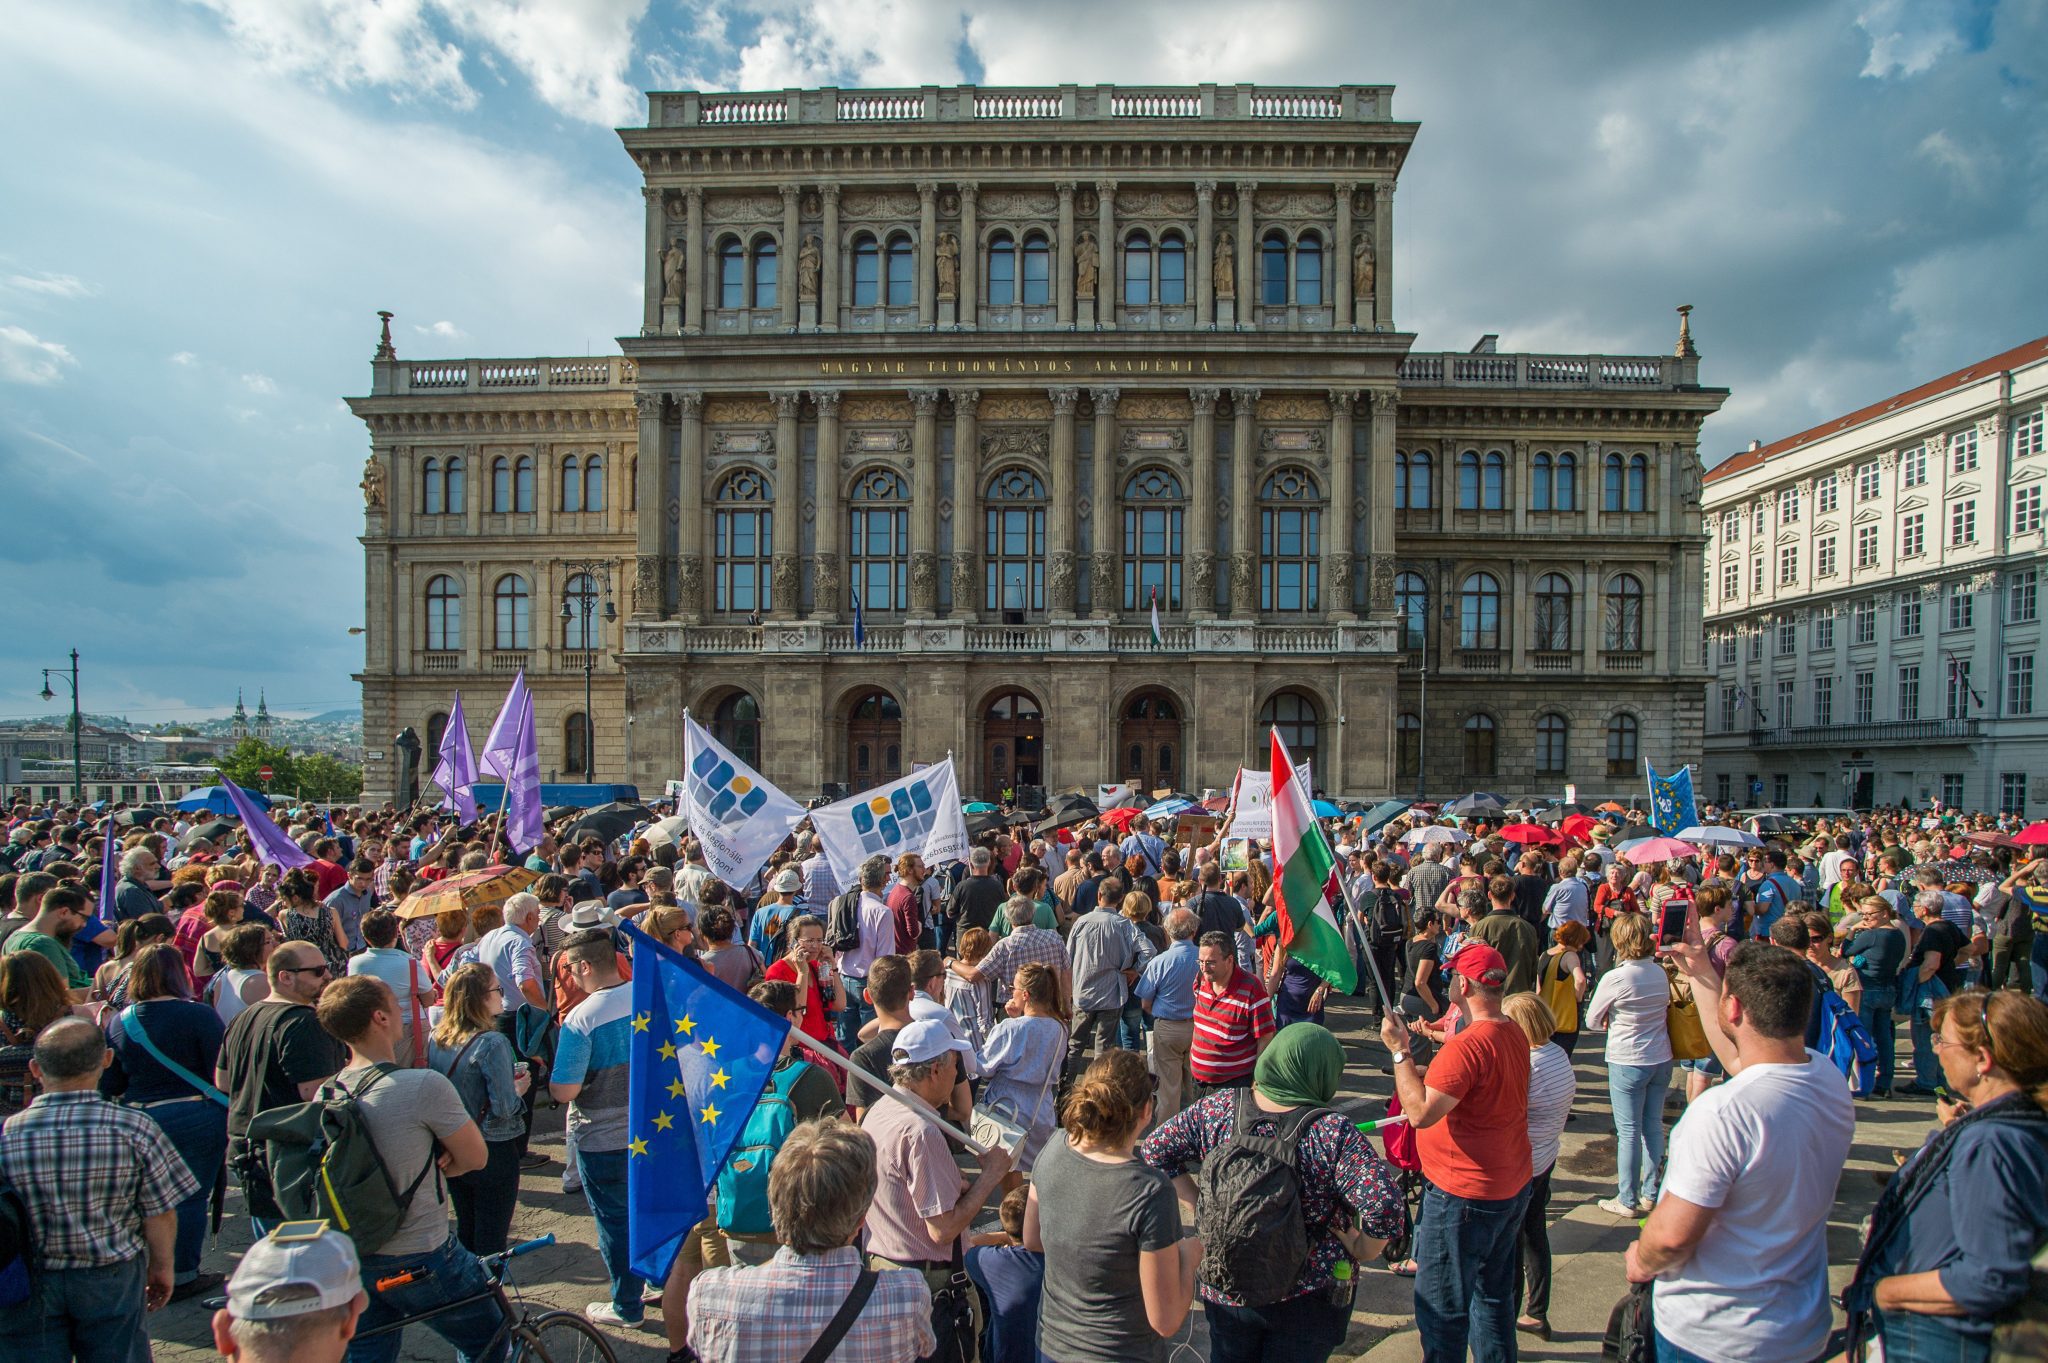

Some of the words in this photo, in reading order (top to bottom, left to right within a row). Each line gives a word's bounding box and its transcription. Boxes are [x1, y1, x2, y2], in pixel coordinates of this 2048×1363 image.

[821, 361, 905, 373] MAGYAR
[926, 358, 1072, 373] TUDOMÁNYOS
[1095, 358, 1209, 372] AKADÉMIA
[705, 830, 744, 865] Regionális
